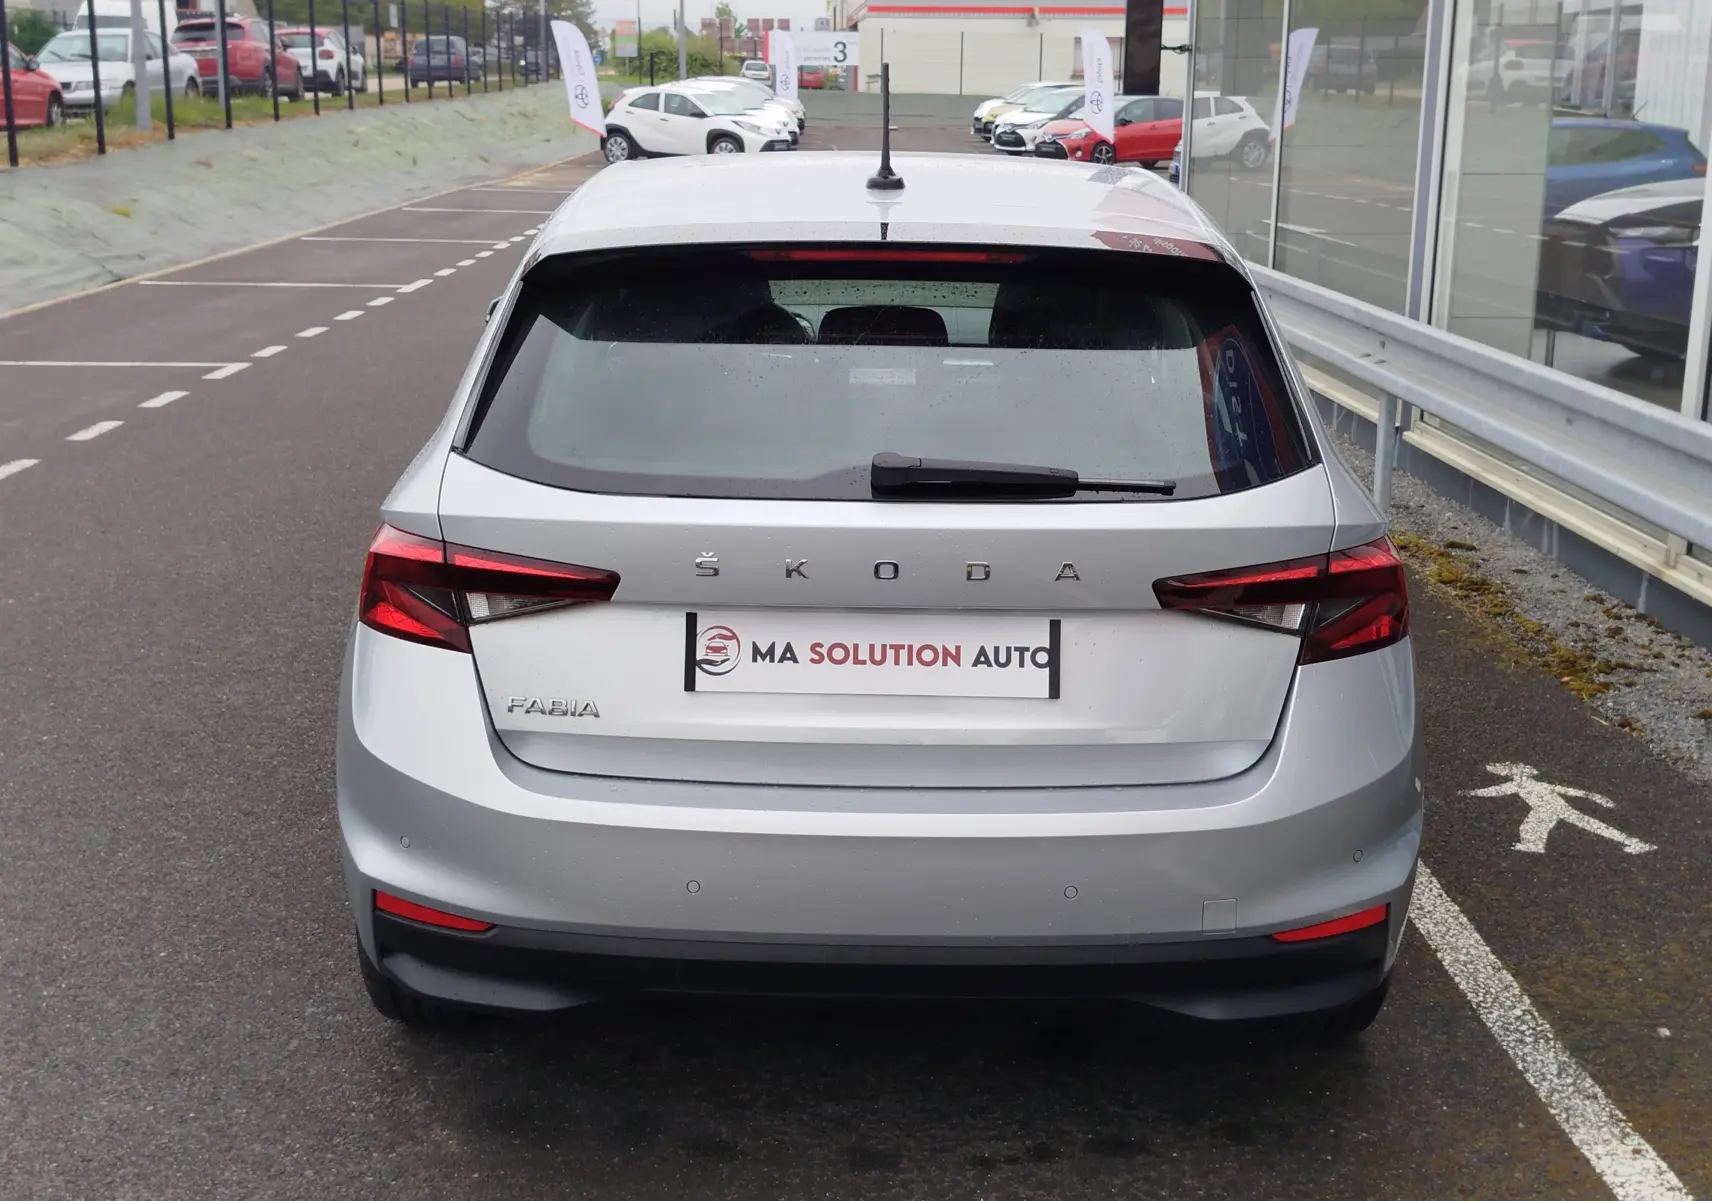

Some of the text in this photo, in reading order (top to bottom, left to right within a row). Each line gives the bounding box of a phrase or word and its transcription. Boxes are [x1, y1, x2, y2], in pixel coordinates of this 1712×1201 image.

[833, 40, 848, 63] 3
[695, 552, 1081, 582] ŠKODA
[751, 640, 1050, 669] MA SOLUTION AUTO
[507, 696, 601, 719] FABIA
